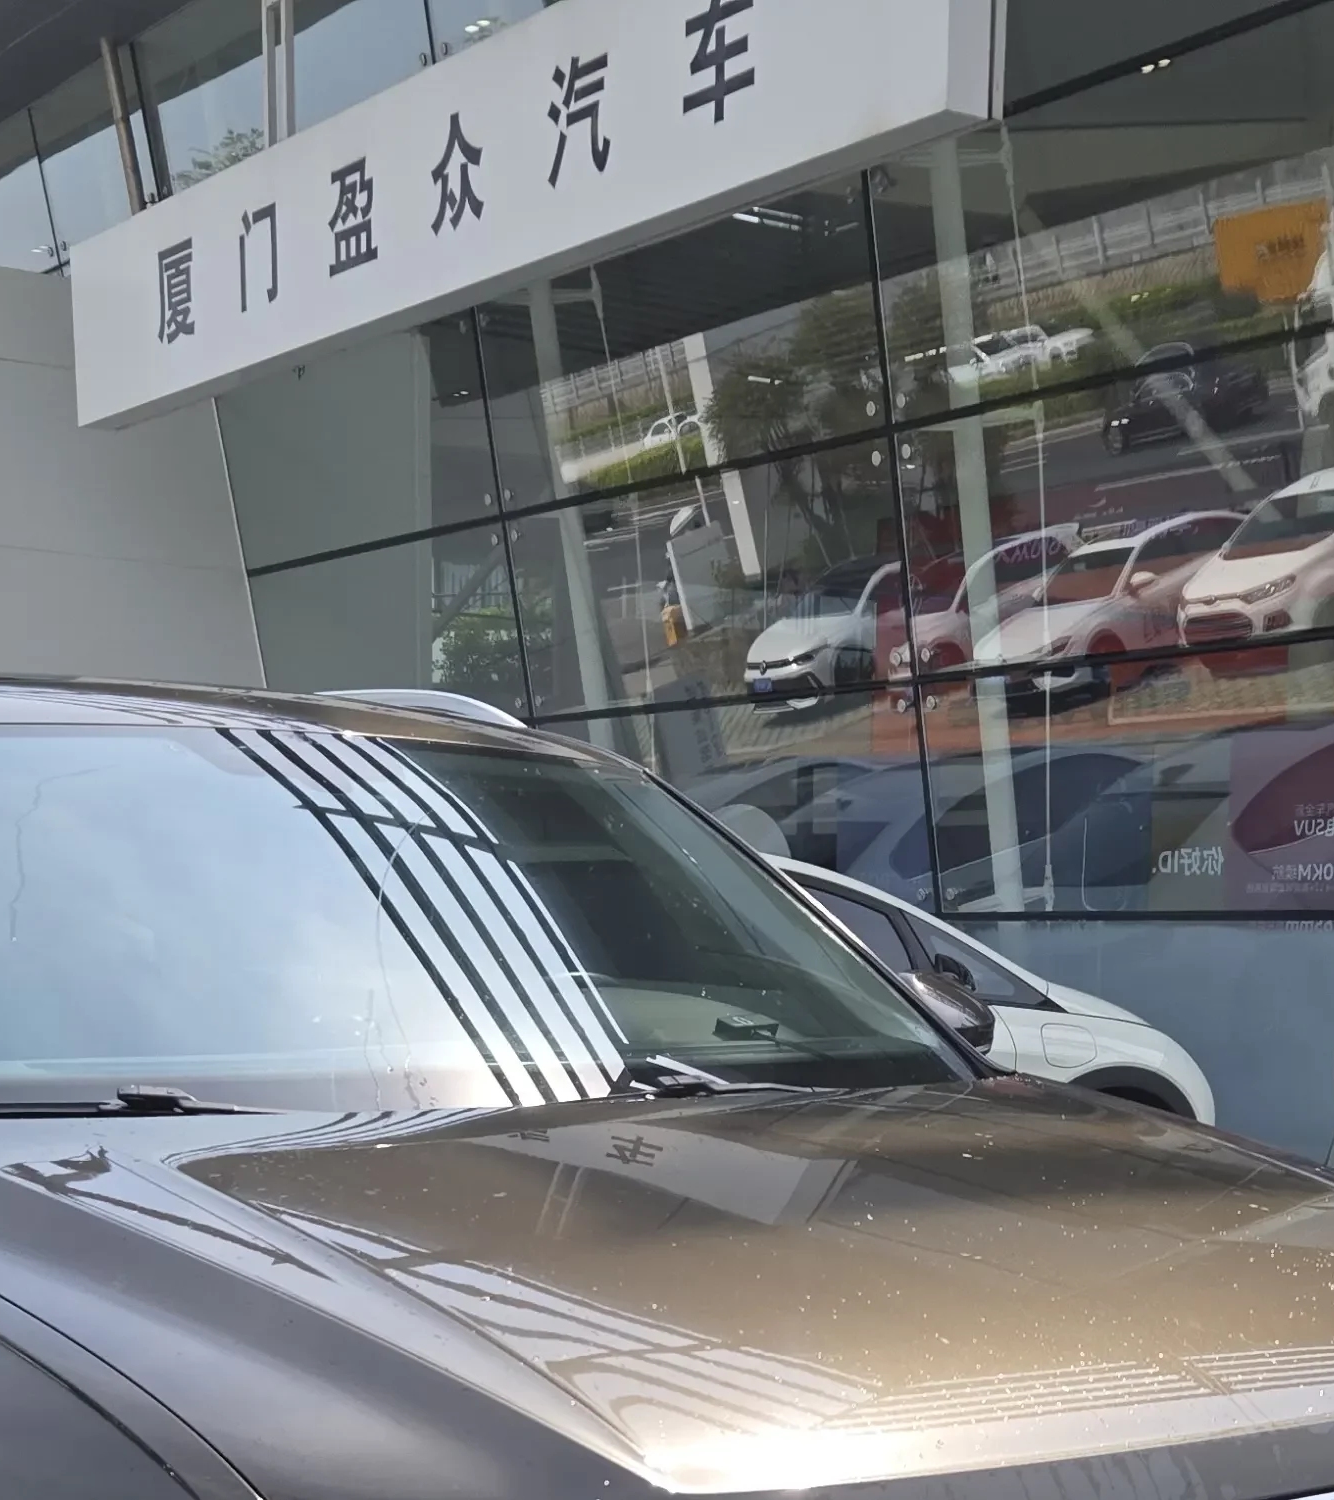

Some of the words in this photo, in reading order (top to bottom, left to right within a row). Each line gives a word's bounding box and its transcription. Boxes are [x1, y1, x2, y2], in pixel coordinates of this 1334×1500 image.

[157, 0, 755, 344] 厦门盈众汽车
